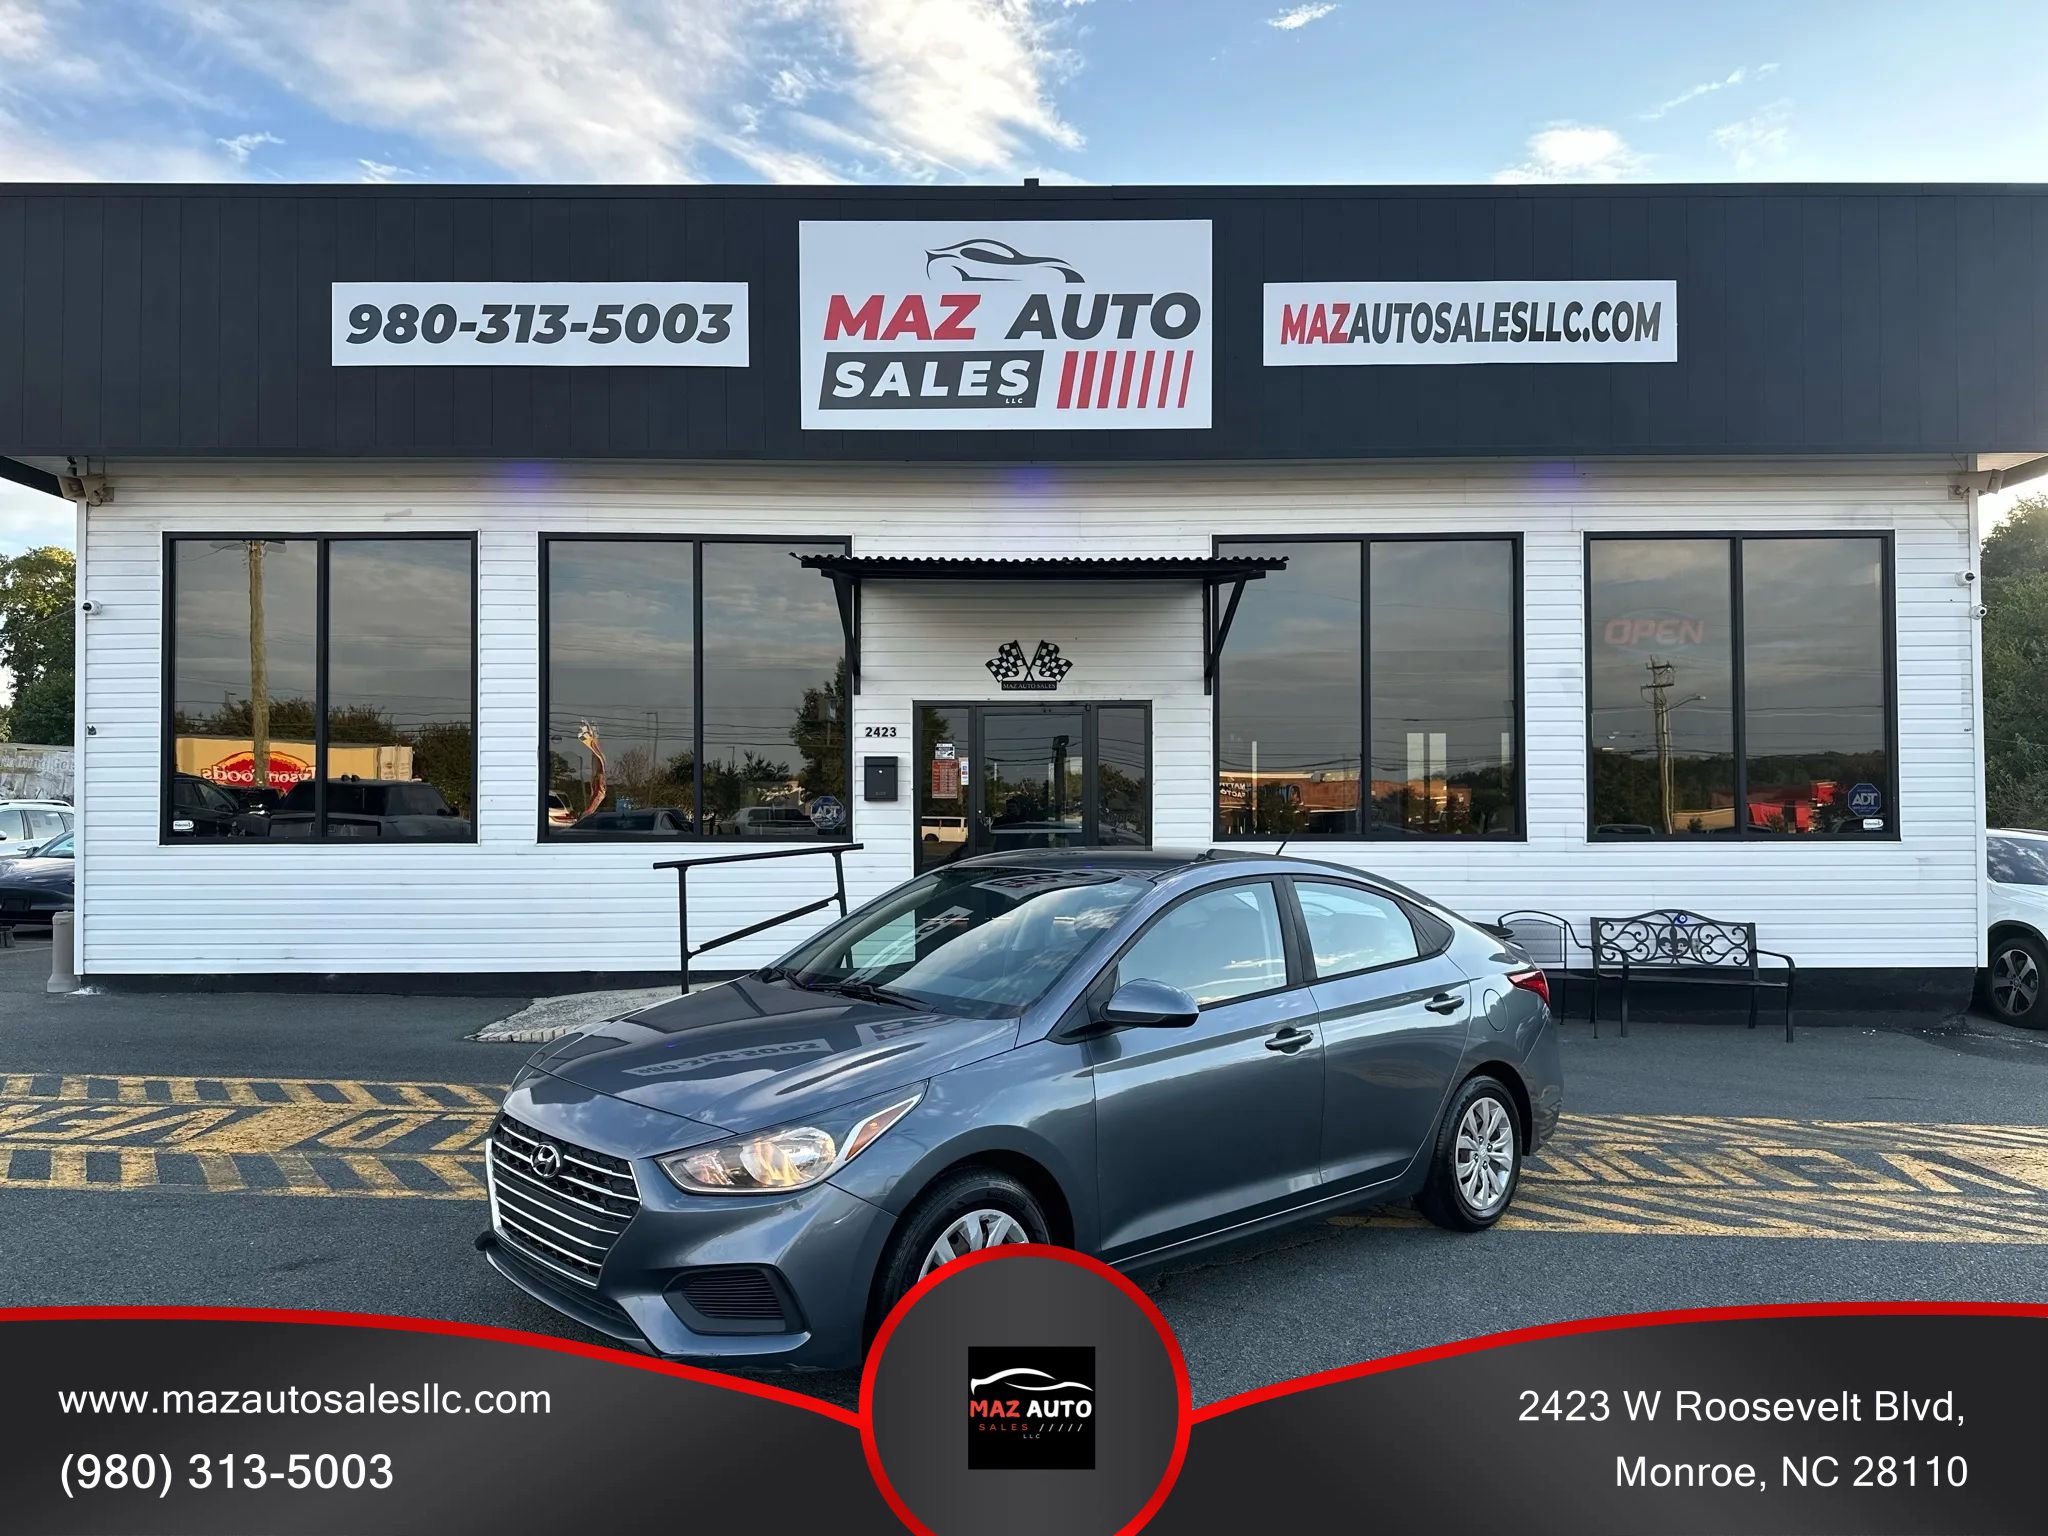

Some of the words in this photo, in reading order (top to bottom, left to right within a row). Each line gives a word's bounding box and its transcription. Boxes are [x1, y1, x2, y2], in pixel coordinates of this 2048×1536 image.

[346, 303, 733, 344] 980-313-5003
[823, 294, 981, 341] MAZ
[1004, 292, 1201, 340] AUTO
[1281, 301, 1662, 344] MAZAUTOSALESLLC.COM
[832, 360, 1031, 398] SALES
[1604, 618, 1704, 645] OPEN
[865, 726, 897, 737] 2423
[815, 805, 841, 818] ADT
[1852, 792, 1878, 806] ADT
